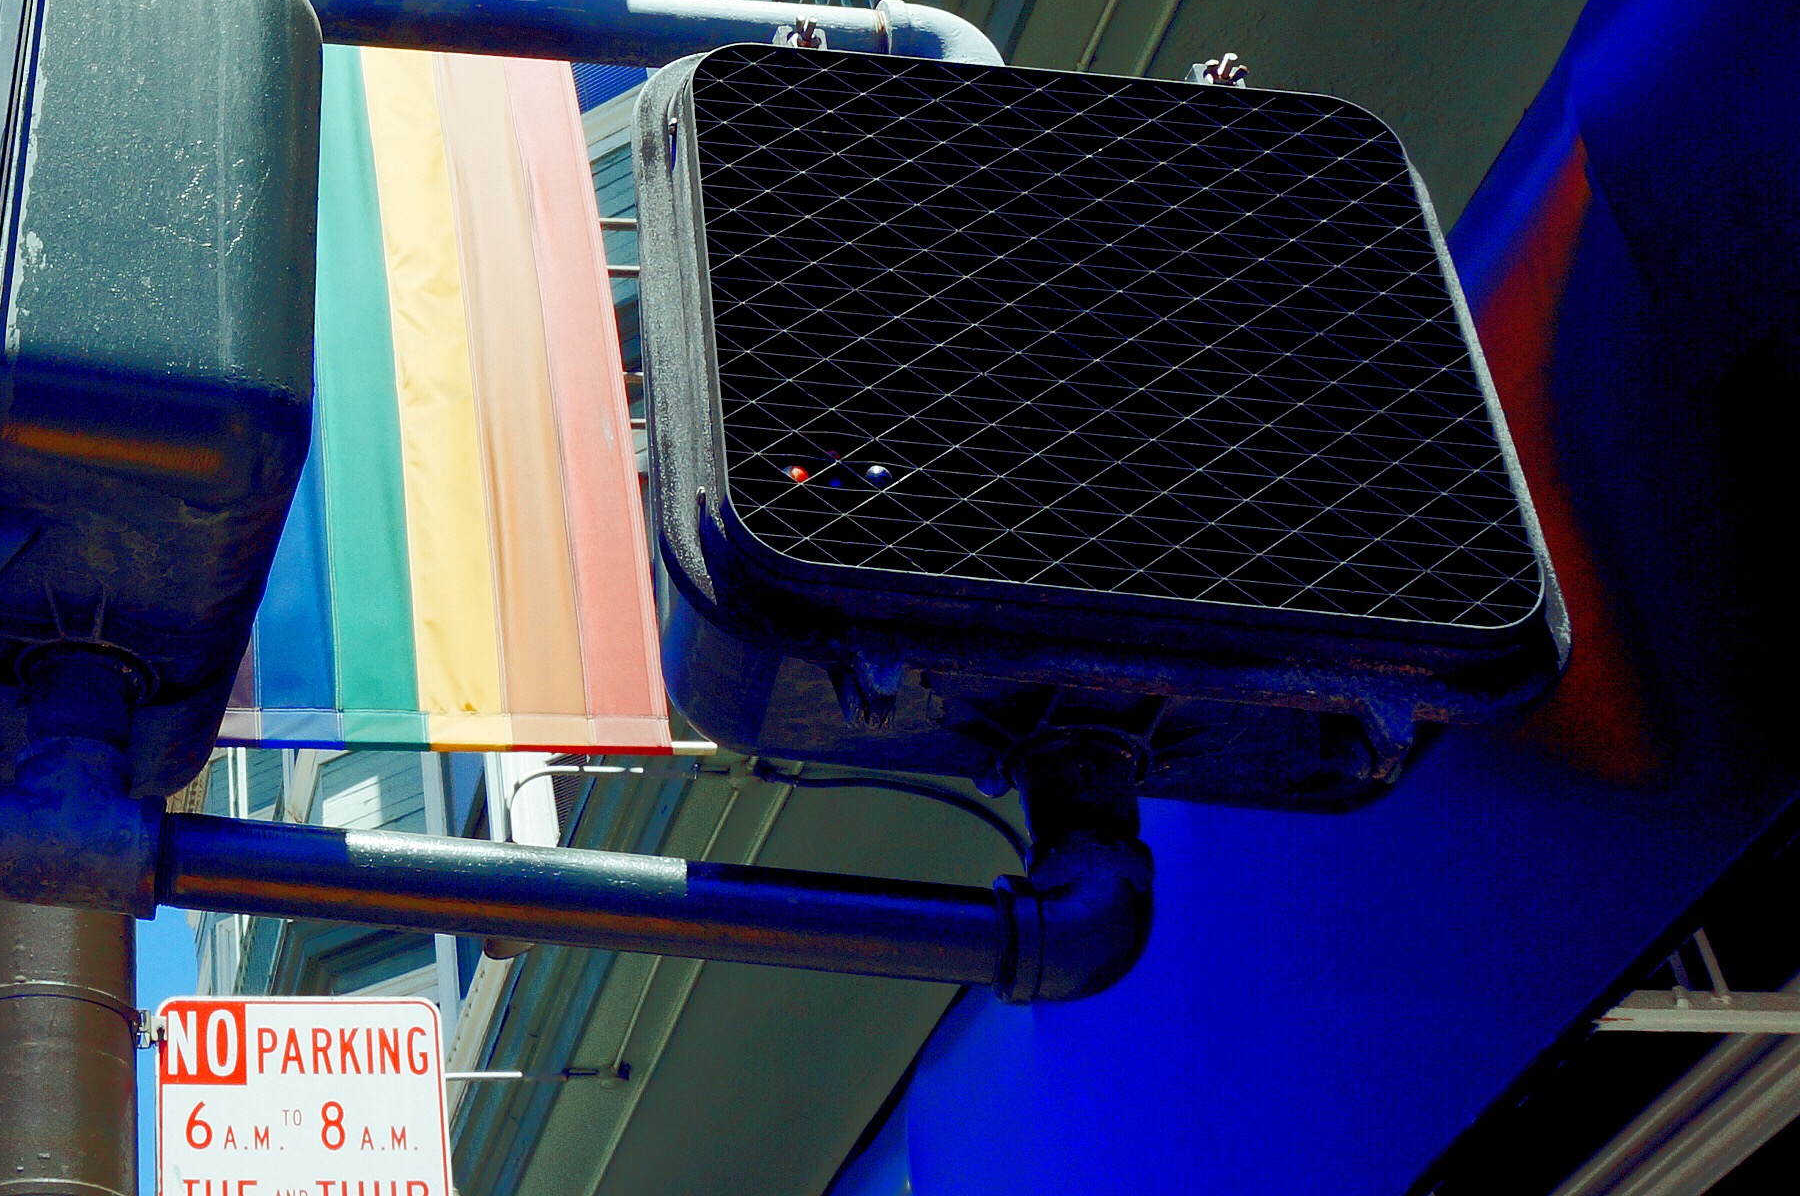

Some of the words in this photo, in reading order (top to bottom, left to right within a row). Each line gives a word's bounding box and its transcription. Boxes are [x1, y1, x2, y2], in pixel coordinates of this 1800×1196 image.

[167, 1009, 239, 1077] NO
[257, 1026, 429, 1076] PARKING
[185, 1101, 213, 1150] 6
[223, 1126, 284, 1151] A.M.
[282, 1109, 302, 1127] TO
[320, 1101, 346, 1151] 8
[360, 1126, 419, 1151] A.M.
